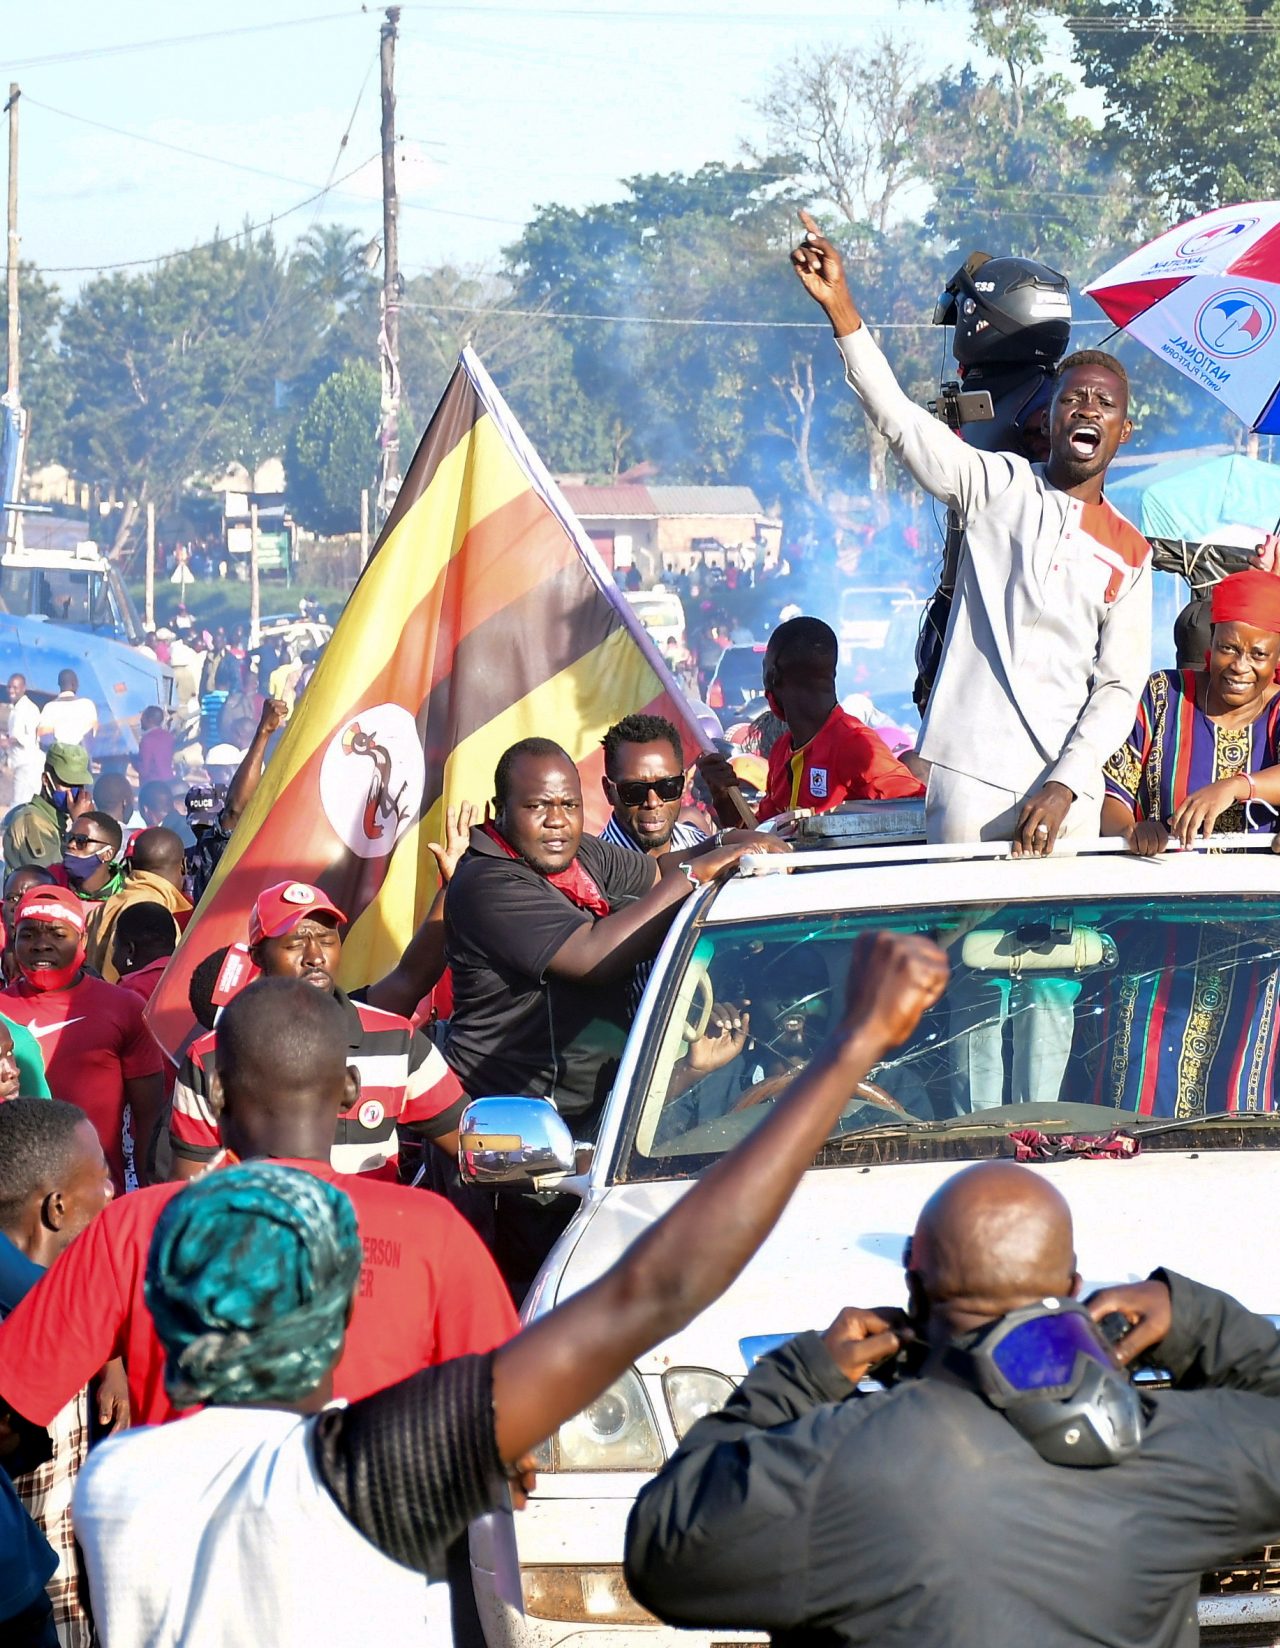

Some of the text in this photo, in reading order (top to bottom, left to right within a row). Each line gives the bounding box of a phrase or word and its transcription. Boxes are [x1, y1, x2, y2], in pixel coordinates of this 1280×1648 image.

[191, 798, 213, 808] POLICE
[363, 1237, 401, 1270] ERSON
[360, 1269, 374, 1298] ER
